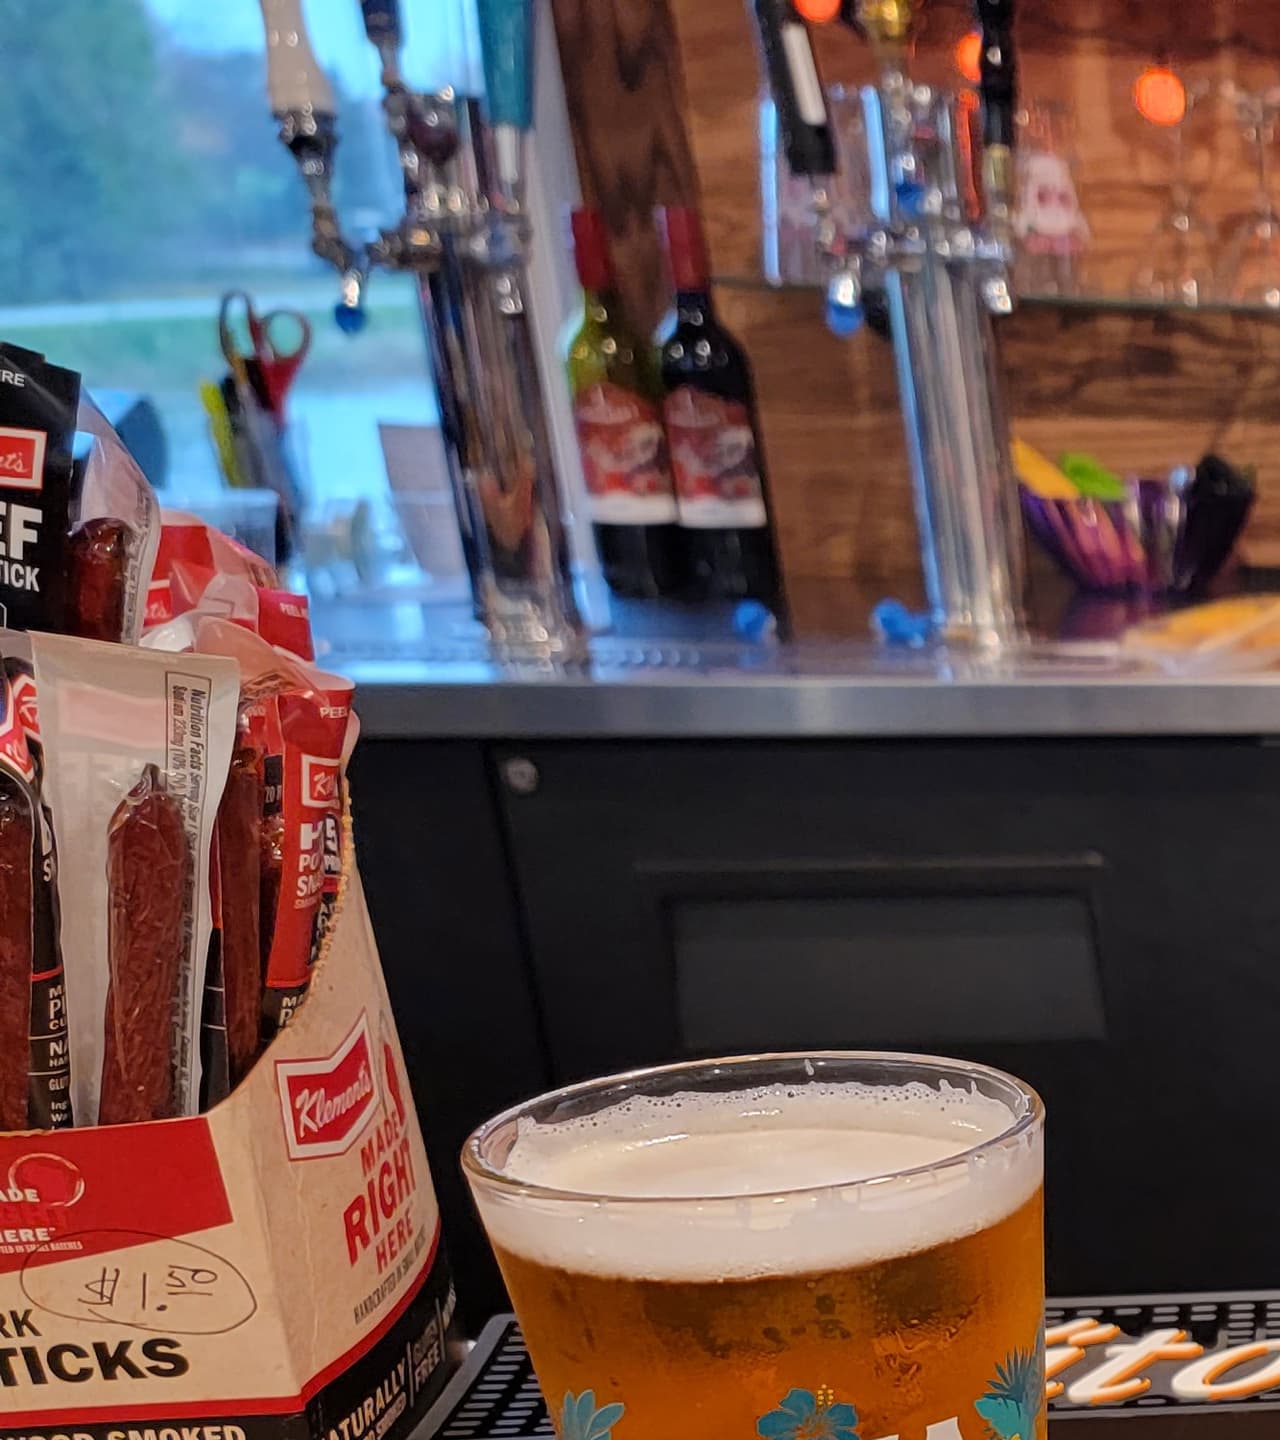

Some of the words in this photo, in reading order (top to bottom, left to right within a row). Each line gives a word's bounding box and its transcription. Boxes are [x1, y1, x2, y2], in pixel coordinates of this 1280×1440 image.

[190, 688, 207, 738] Nutrition
[189, 740, 205, 770] Facts
[360, 1110, 399, 1177] MADE
[375, 1203, 415, 1275] HERE
